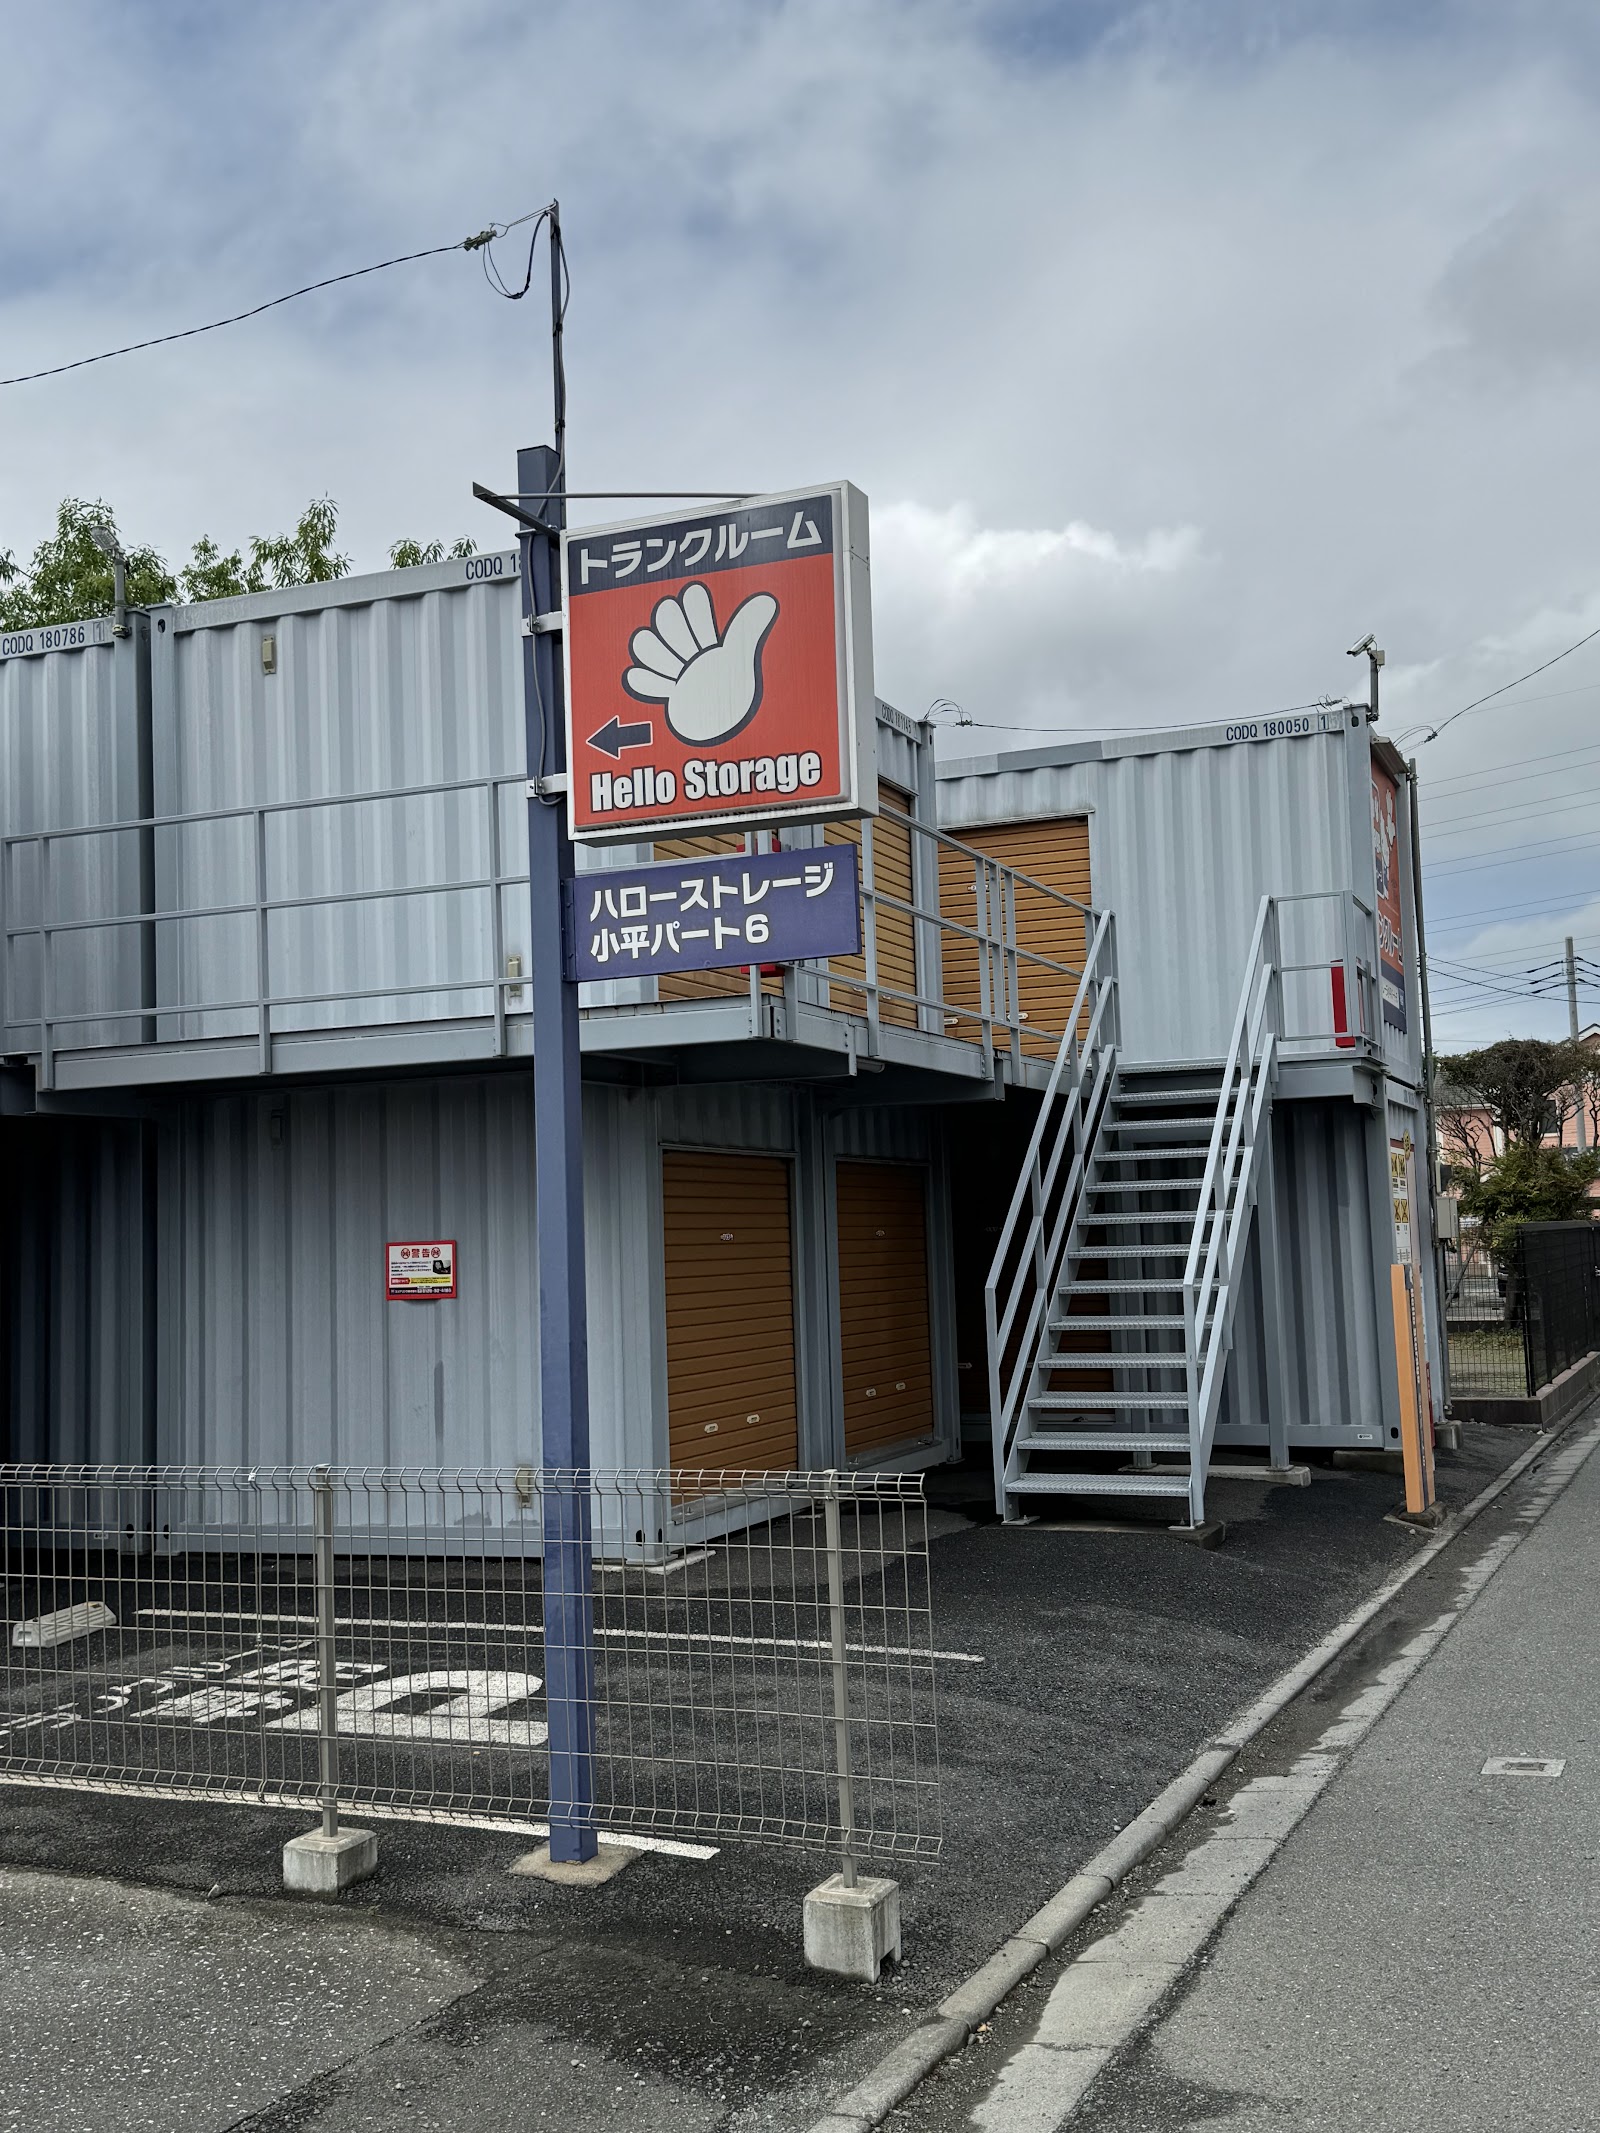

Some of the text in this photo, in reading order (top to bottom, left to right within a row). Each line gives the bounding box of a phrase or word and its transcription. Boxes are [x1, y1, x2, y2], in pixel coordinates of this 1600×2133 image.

[466, 556, 503, 580] CODQ
[580, 511, 823, 585] トランクルーム
[2, 634, 34, 655] CODQ
[39, 626, 85, 649] 180786
[1226, 724, 1258, 741] CODQ
[1263, 717, 1310, 736] 180050
[590, 751, 822, 813] Hello Storage
[590, 862, 834, 922] ハローストレージ
[590, 913, 769, 962] 小平パート6
